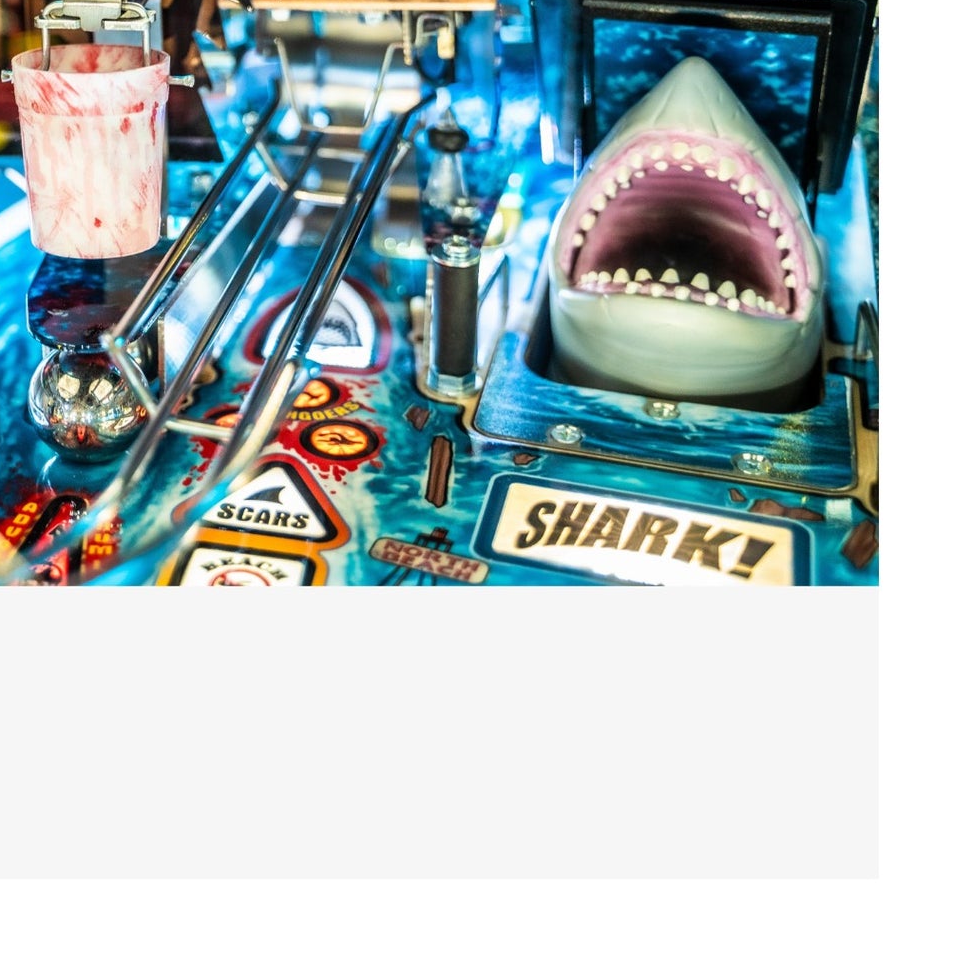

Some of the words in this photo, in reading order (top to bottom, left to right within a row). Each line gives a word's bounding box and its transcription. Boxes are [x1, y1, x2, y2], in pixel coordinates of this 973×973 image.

[217, 502, 309, 529] SCARS
[516, 501, 774, 579] SHARK!
[381, 551, 472, 580] BEACH
[384, 540, 480, 572] NORTH
